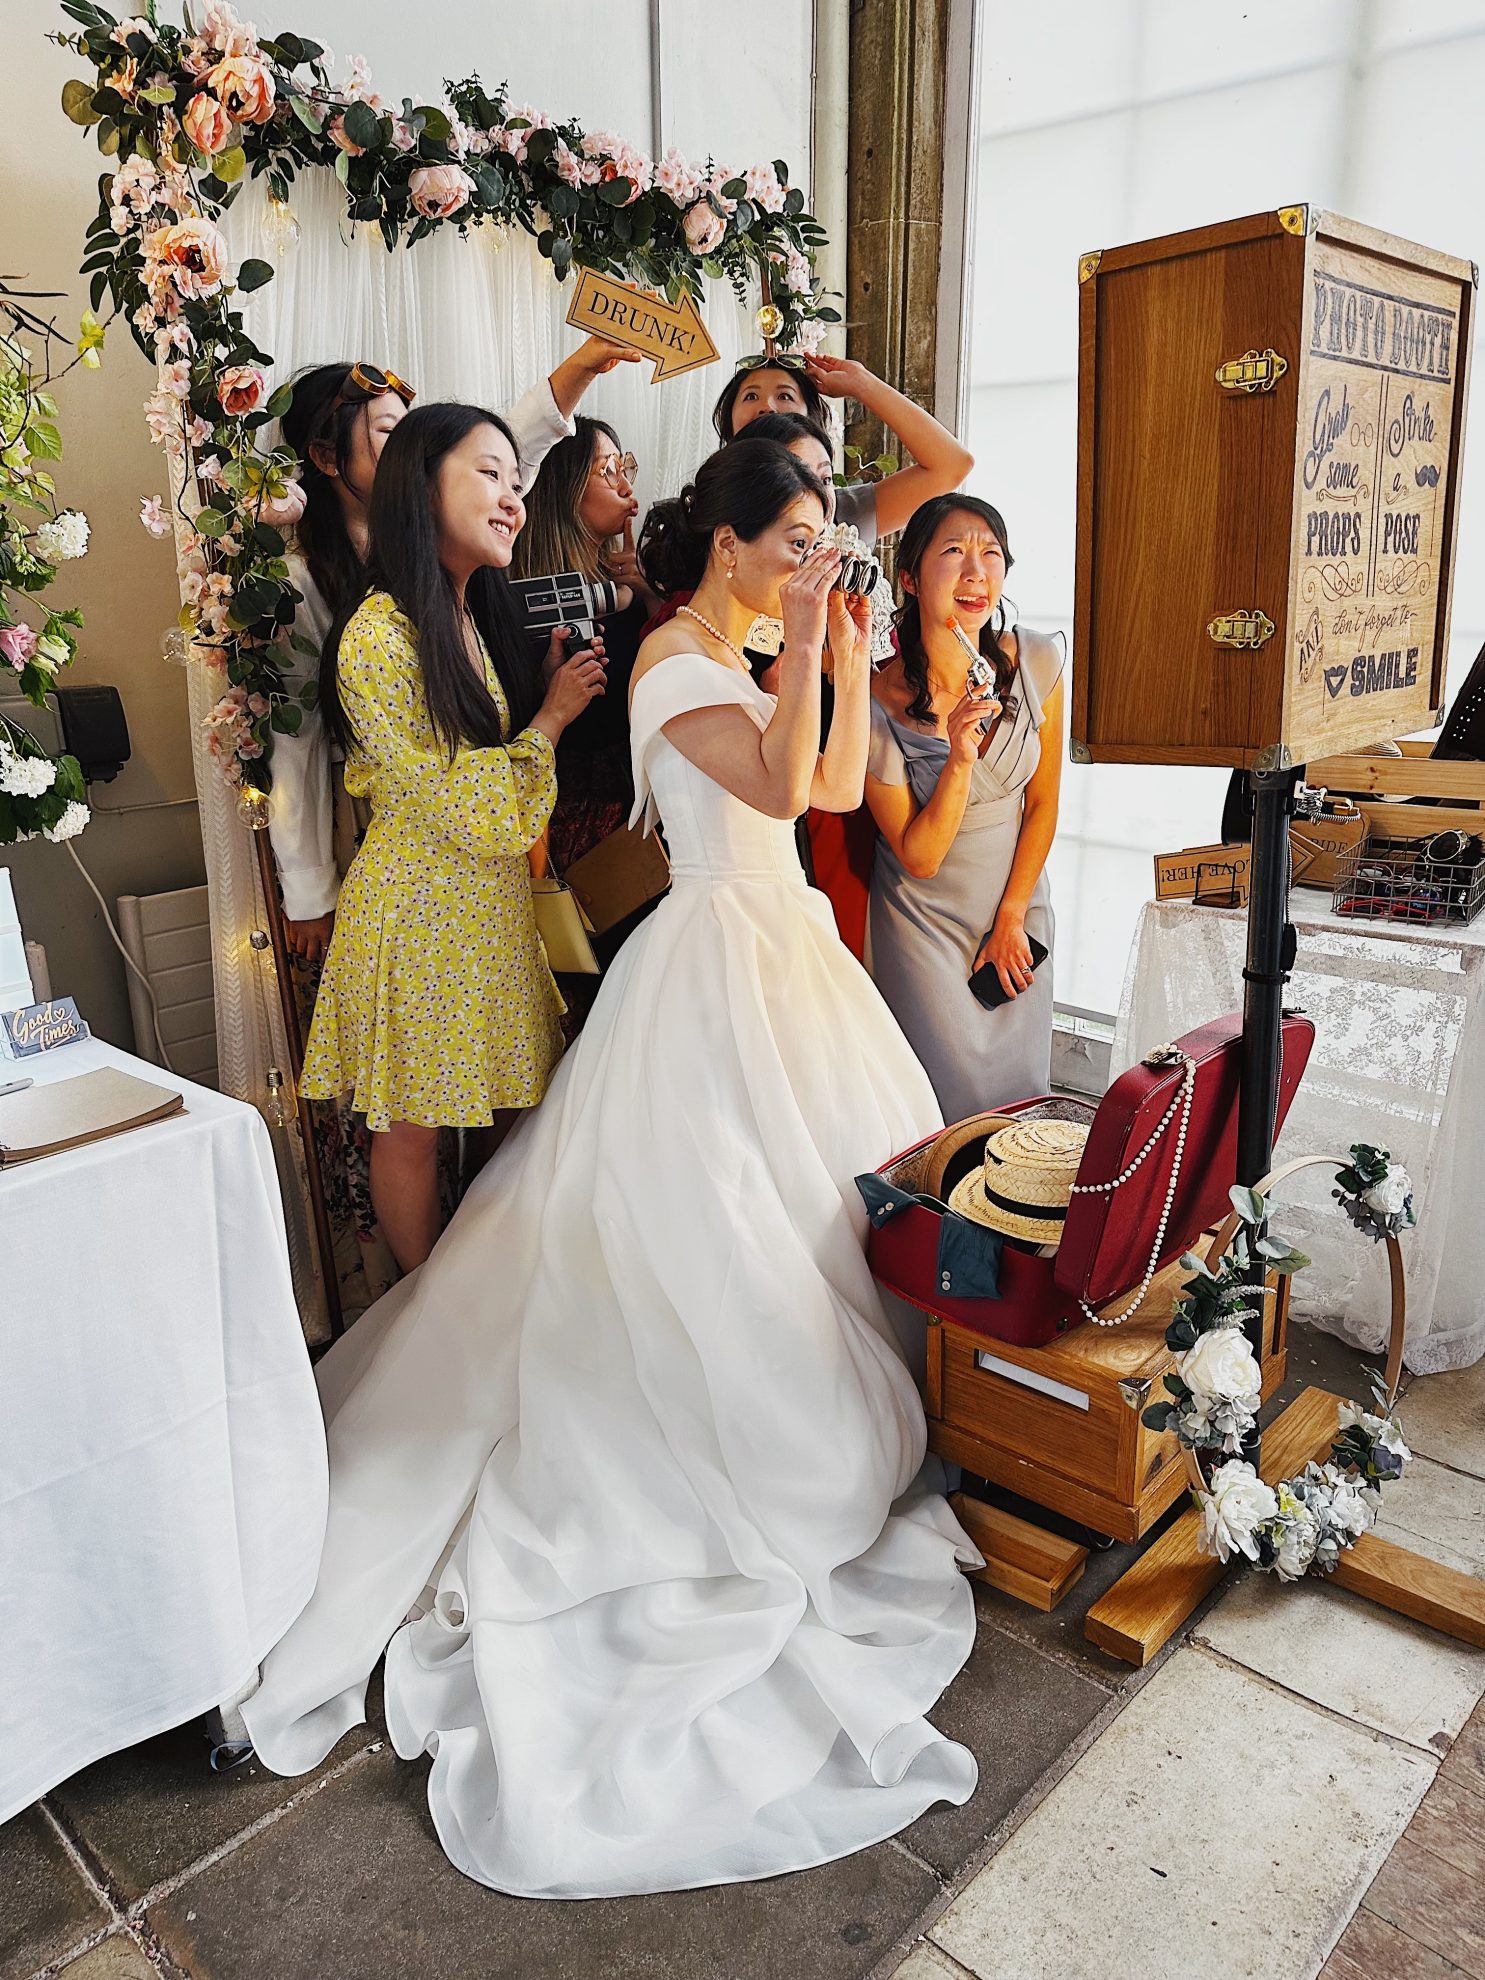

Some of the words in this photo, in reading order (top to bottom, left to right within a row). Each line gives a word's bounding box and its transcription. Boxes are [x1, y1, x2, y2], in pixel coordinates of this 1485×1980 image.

[587, 290, 696, 355] DRUNK!
[1311, 279, 1387, 362] PHOTO
[1389, 303, 1453, 376] BOOTH
[1303, 384, 1354, 490] Grab
[1388, 391, 1438, 458] Strike
[1326, 461, 1360, 490] some
[1392, 472, 1403, 493] a
[1305, 510, 1361, 557] PROPS
[1382, 512, 1421, 557] POSE
[1299, 620, 1323, 675] AND
[1332, 606, 1365, 635] don't
[1357, 604, 1399, 653] forget
[1350, 646, 1419, 697] SMILE
[1161, 864, 1202, 883] HER!
[1209, 859, 1251, 877] OVE
[12, 1002, 56, 1046] Good
[30, 1020, 79, 1051] Times
